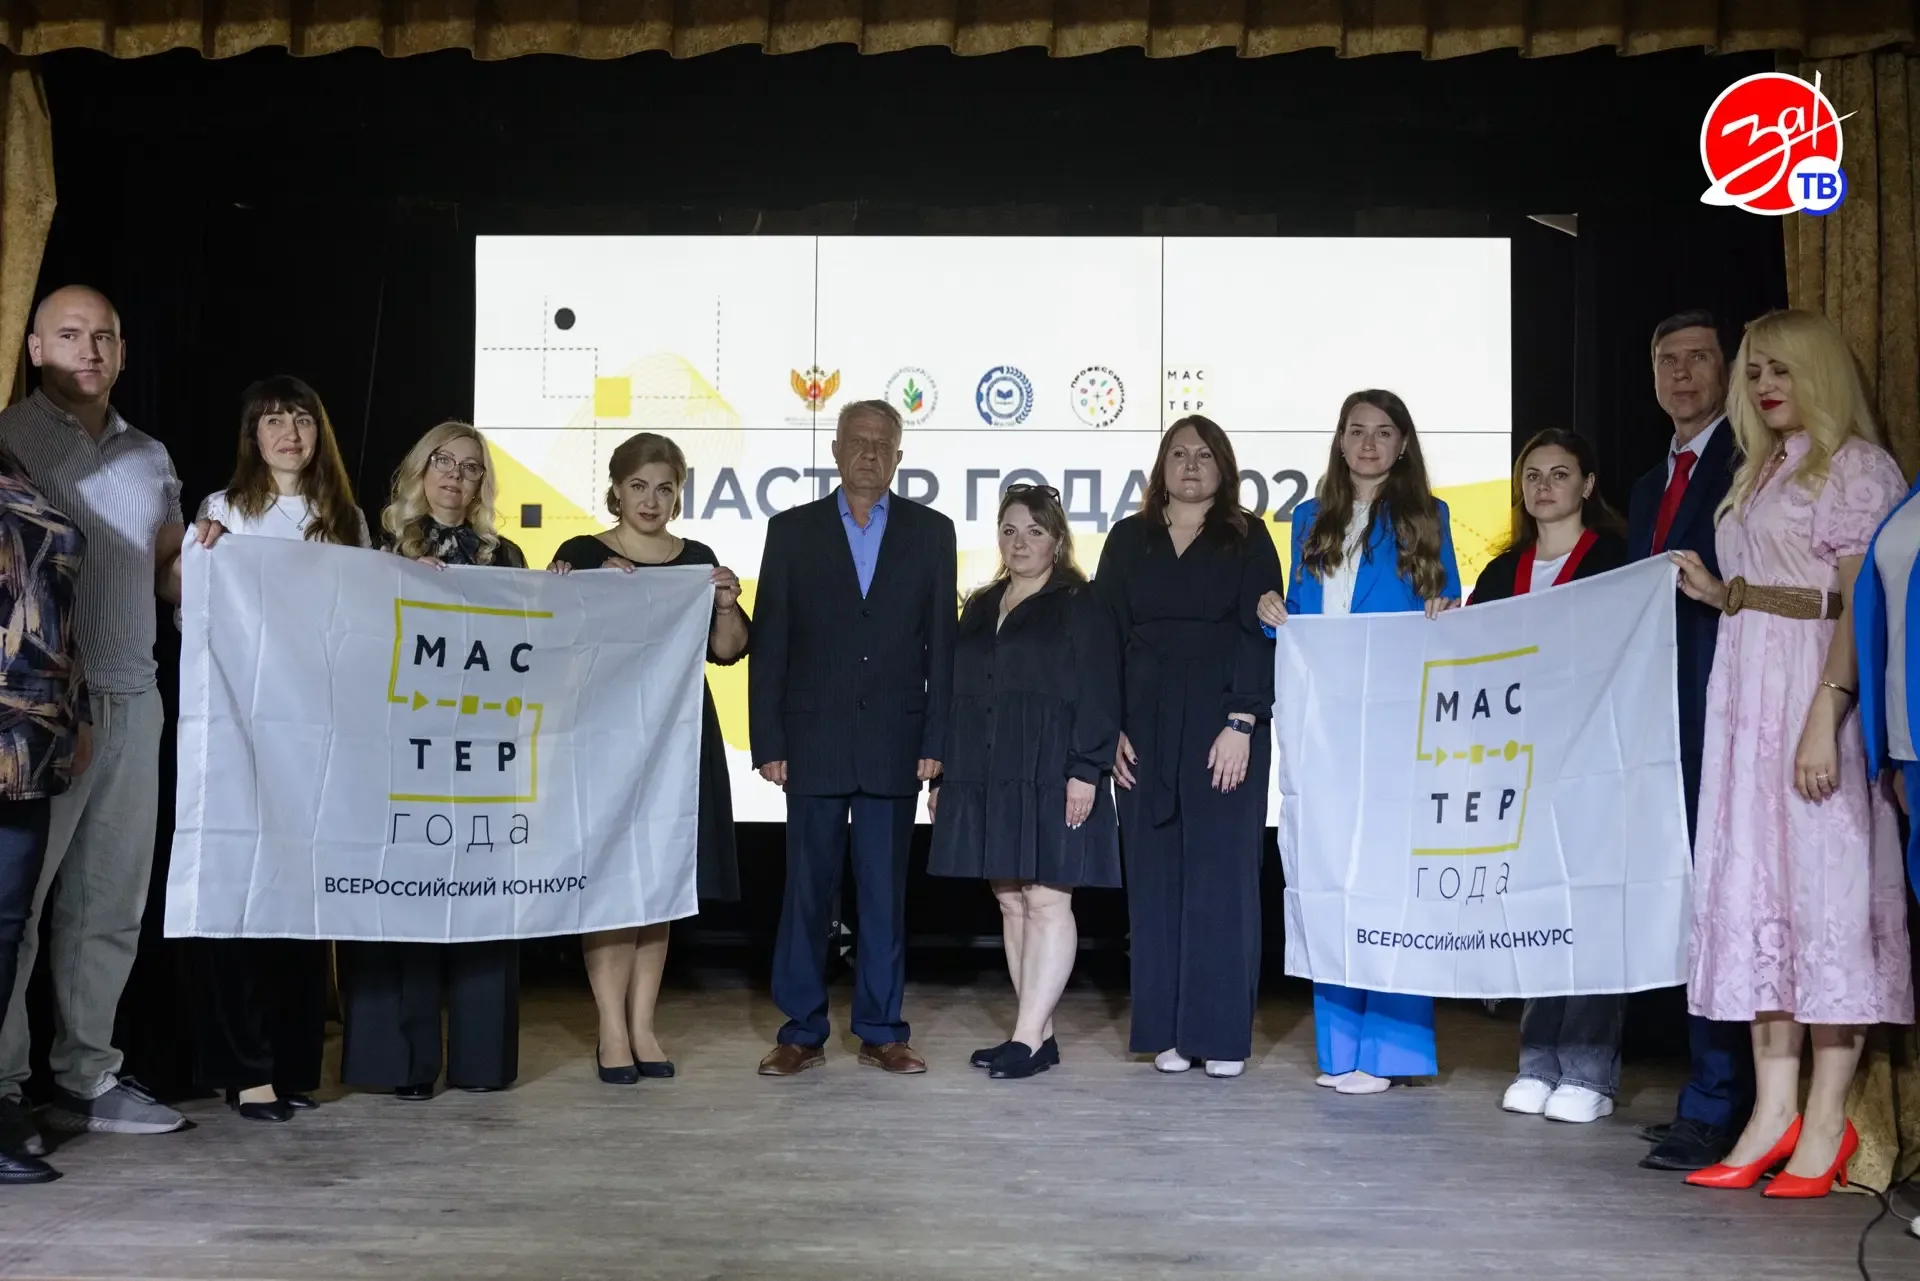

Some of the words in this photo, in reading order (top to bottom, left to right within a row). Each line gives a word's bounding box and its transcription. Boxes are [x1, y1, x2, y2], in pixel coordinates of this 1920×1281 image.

[1167, 370, 1204, 380] МАС
[1169, 400, 1204, 411] ТЕР
[682, 467, 940, 520] АСТР
[413, 634, 534, 673] МАС
[1435, 682, 1522, 722] МАС
[409, 738, 517, 772] ТЕР
[1431, 788, 1516, 824] ТЕР
[324, 876, 496, 897] ВСЕРОССИЙСКИЙ
[502, 875, 588, 895] КОНКУРС
[1356, 928, 1486, 951] ВСЕРОССИЙСКИЙ
[1490, 928, 1574, 949] КОНКУРС
